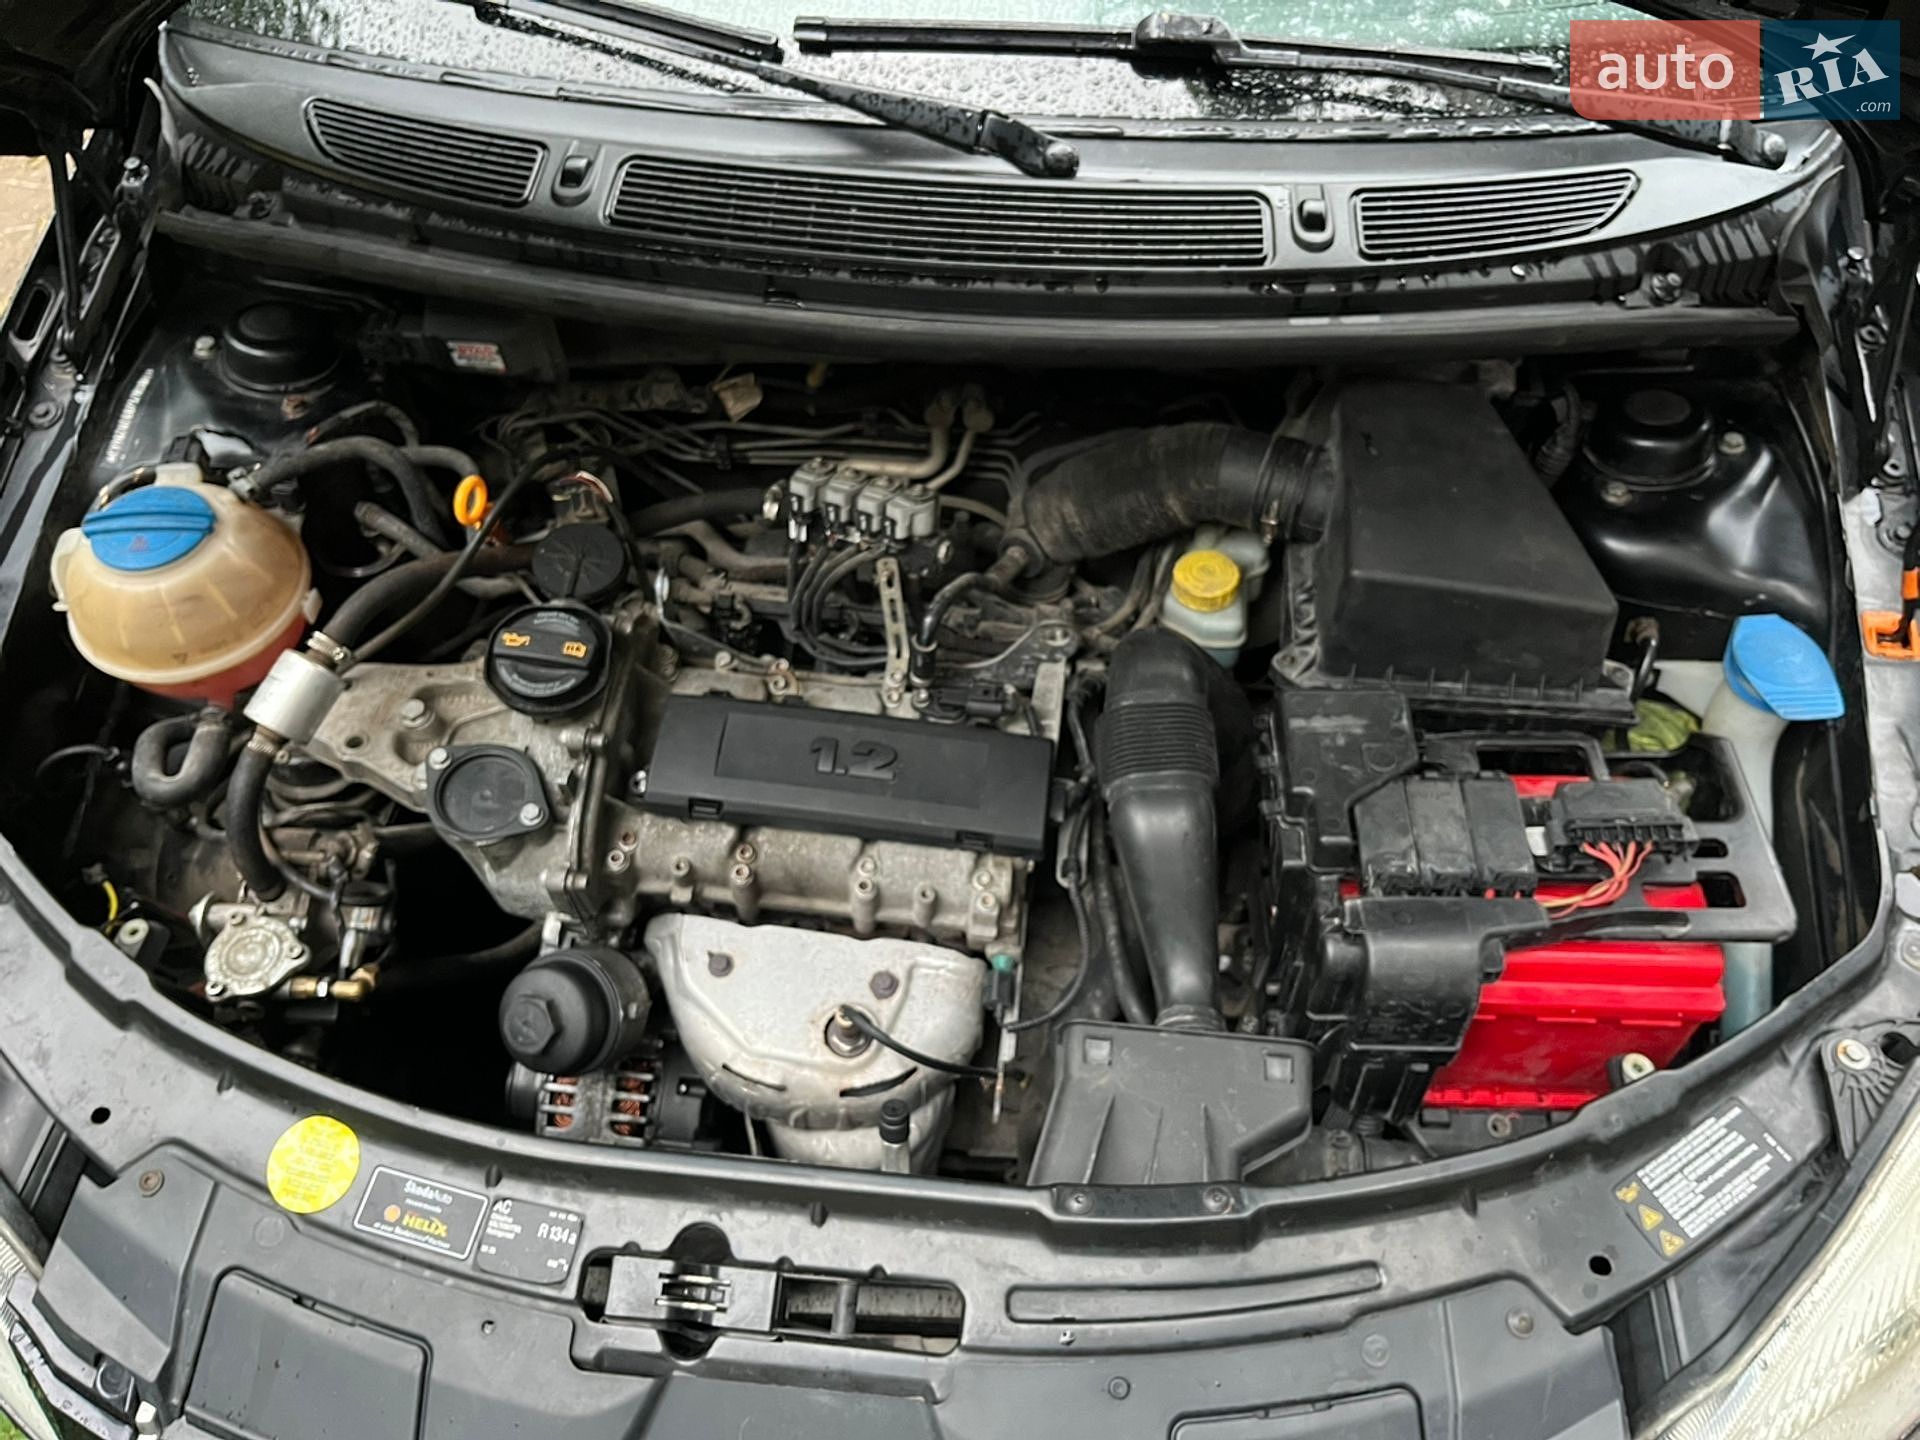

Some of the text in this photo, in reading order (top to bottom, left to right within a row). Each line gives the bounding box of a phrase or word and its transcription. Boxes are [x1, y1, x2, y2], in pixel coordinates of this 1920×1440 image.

[810, 737, 897, 780] 1.2
[493, 1199, 513, 1214] AC
[402, 1213, 449, 1238] HELIX
